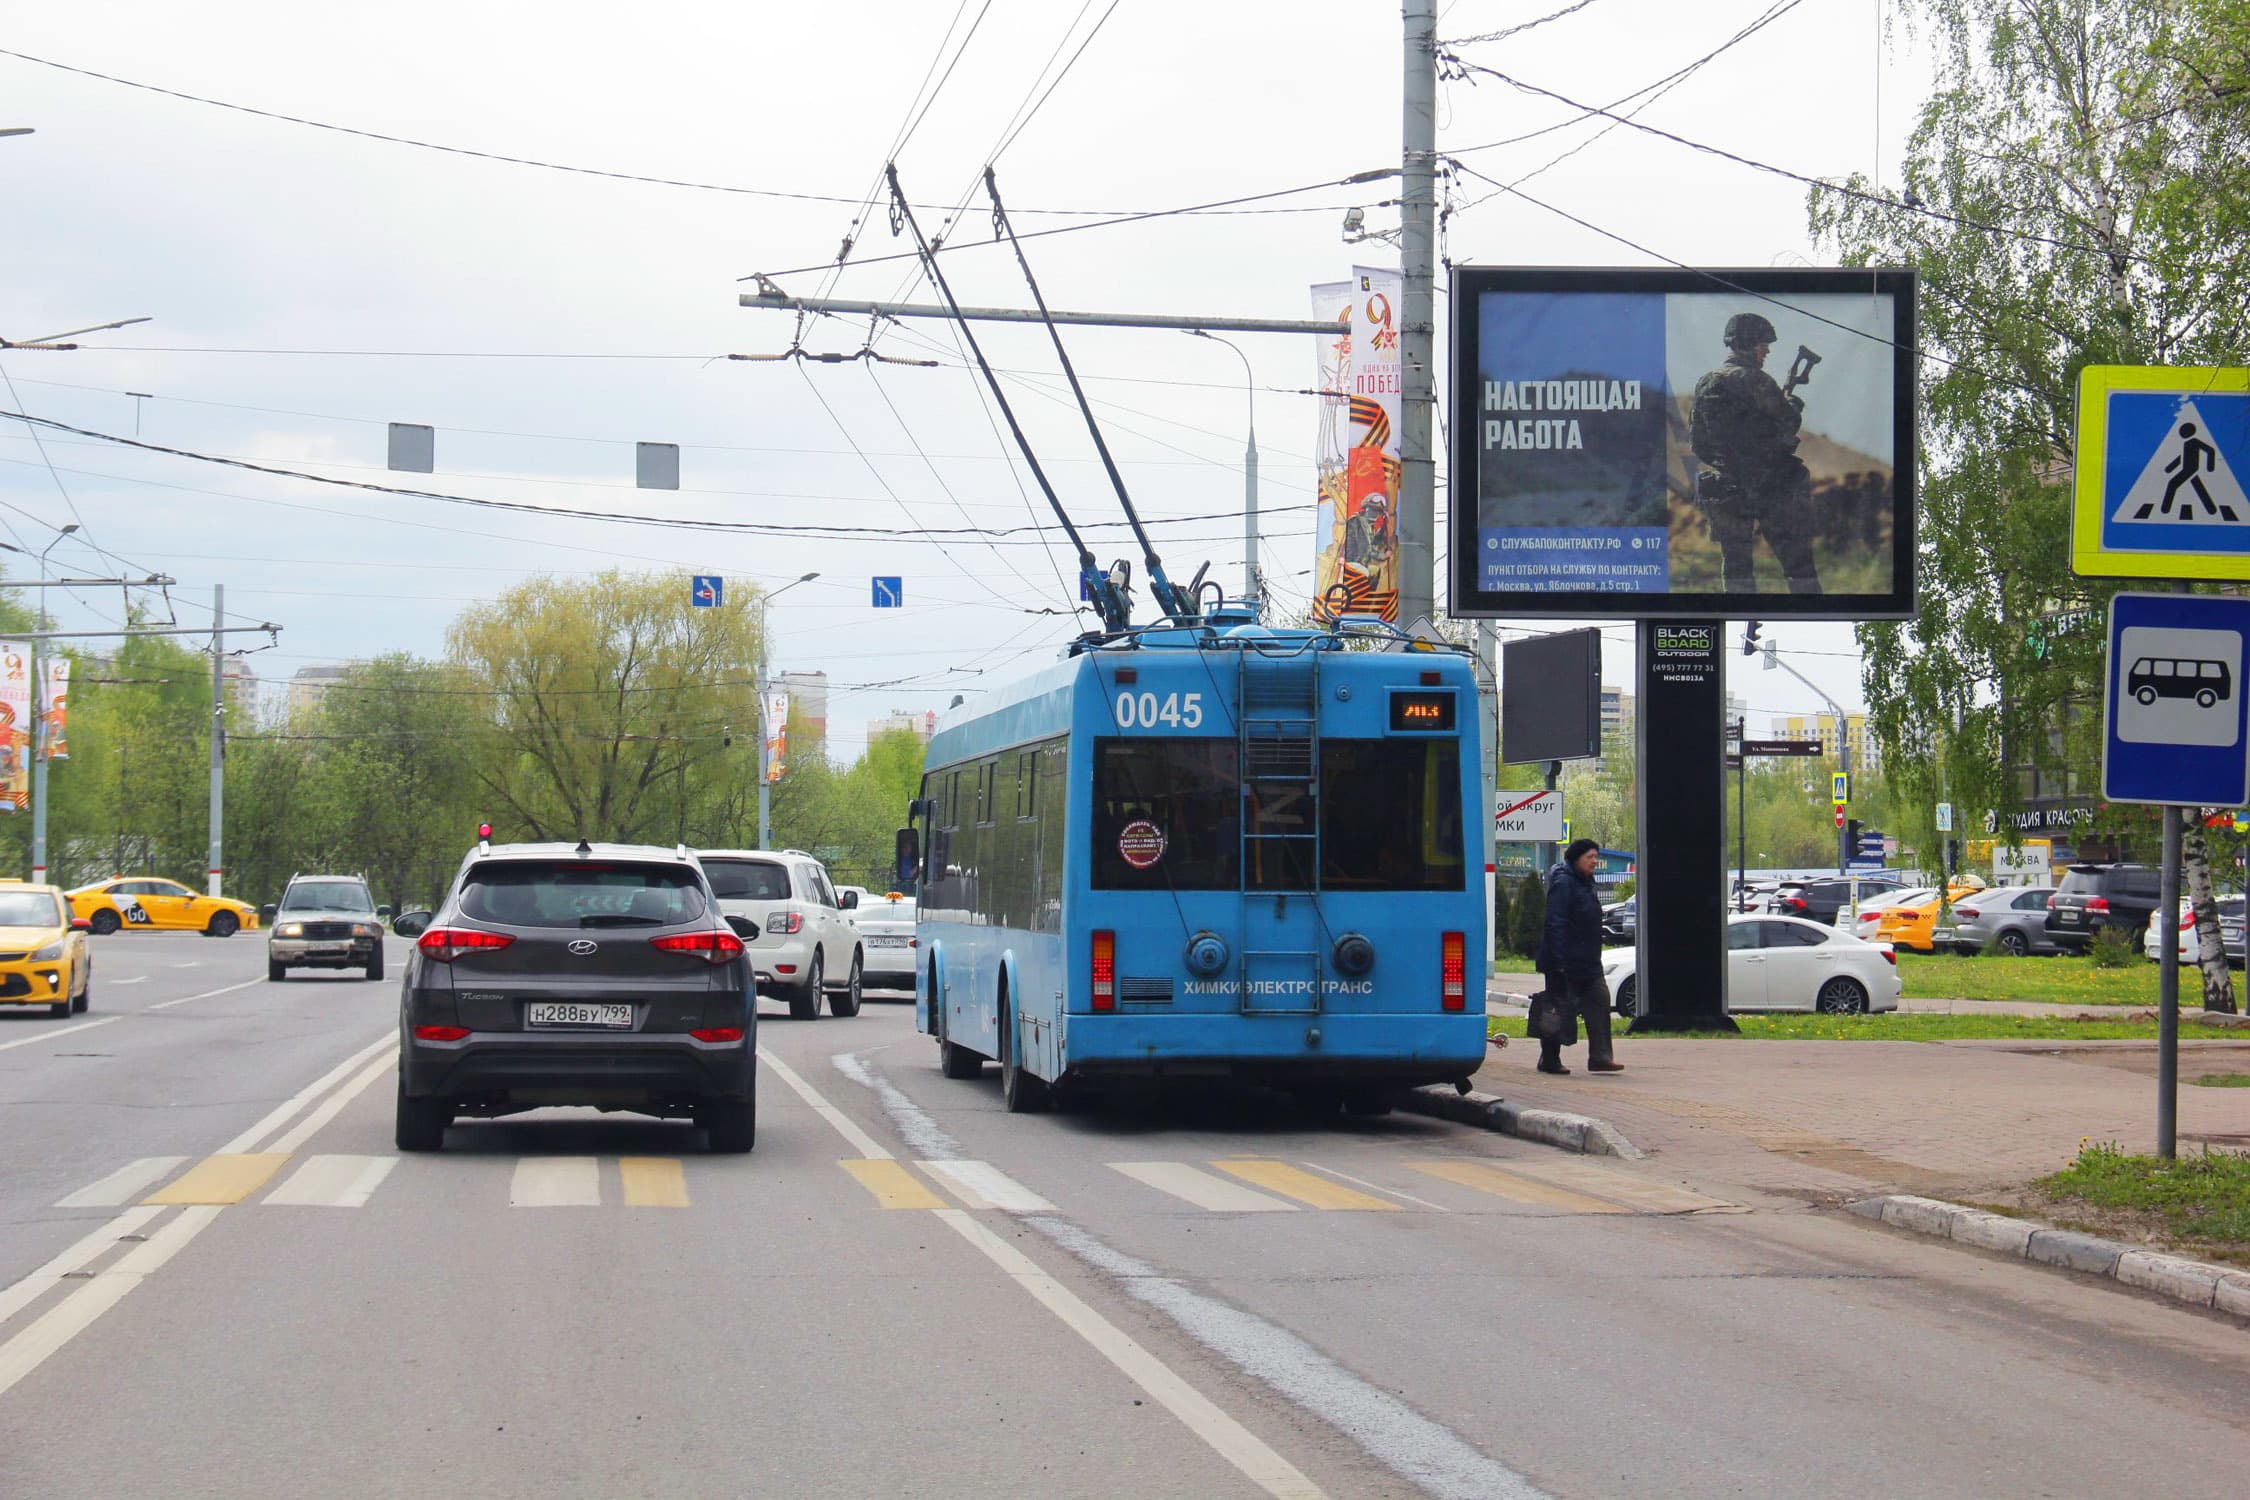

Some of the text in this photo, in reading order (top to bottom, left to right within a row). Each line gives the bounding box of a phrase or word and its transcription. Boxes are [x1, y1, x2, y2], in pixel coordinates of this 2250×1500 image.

[1357, 374, 1401, 395] ПОБЕД
[1485, 380, 1641, 412] НАСТОЯЩАЯ
[1485, 419, 1584, 450] РАБОТА
[1501, 537, 1661, 550] СЛУЖБАПОКОНТРАКТУ.РФ 117
[1488, 564, 1661, 576] ПУНКТ ОТБОРА НА СЛУЖБУ ПО КОНТРАКТУ:
[1497, 581, 1533, 592] Москва,
[1535, 582, 1547, 593] ул.
[1549, 581, 1599, 592] Яблочкова,
[1657, 628, 1709, 638] BLACK
[1657, 638, 1710, 649] BOARD
[1652, 664, 1714, 672] (495) 777 77 31
[1116, 692, 1203, 728] 0045
[1497, 801, 1555, 814] ой округ
[1495, 820, 1525, 832] МКИ
[2007, 810, 2040, 830] ТУДИЯ
[461, 991, 505, 1001] TUCSON
[535, 1004, 629, 1022] Н288ВУ 799
